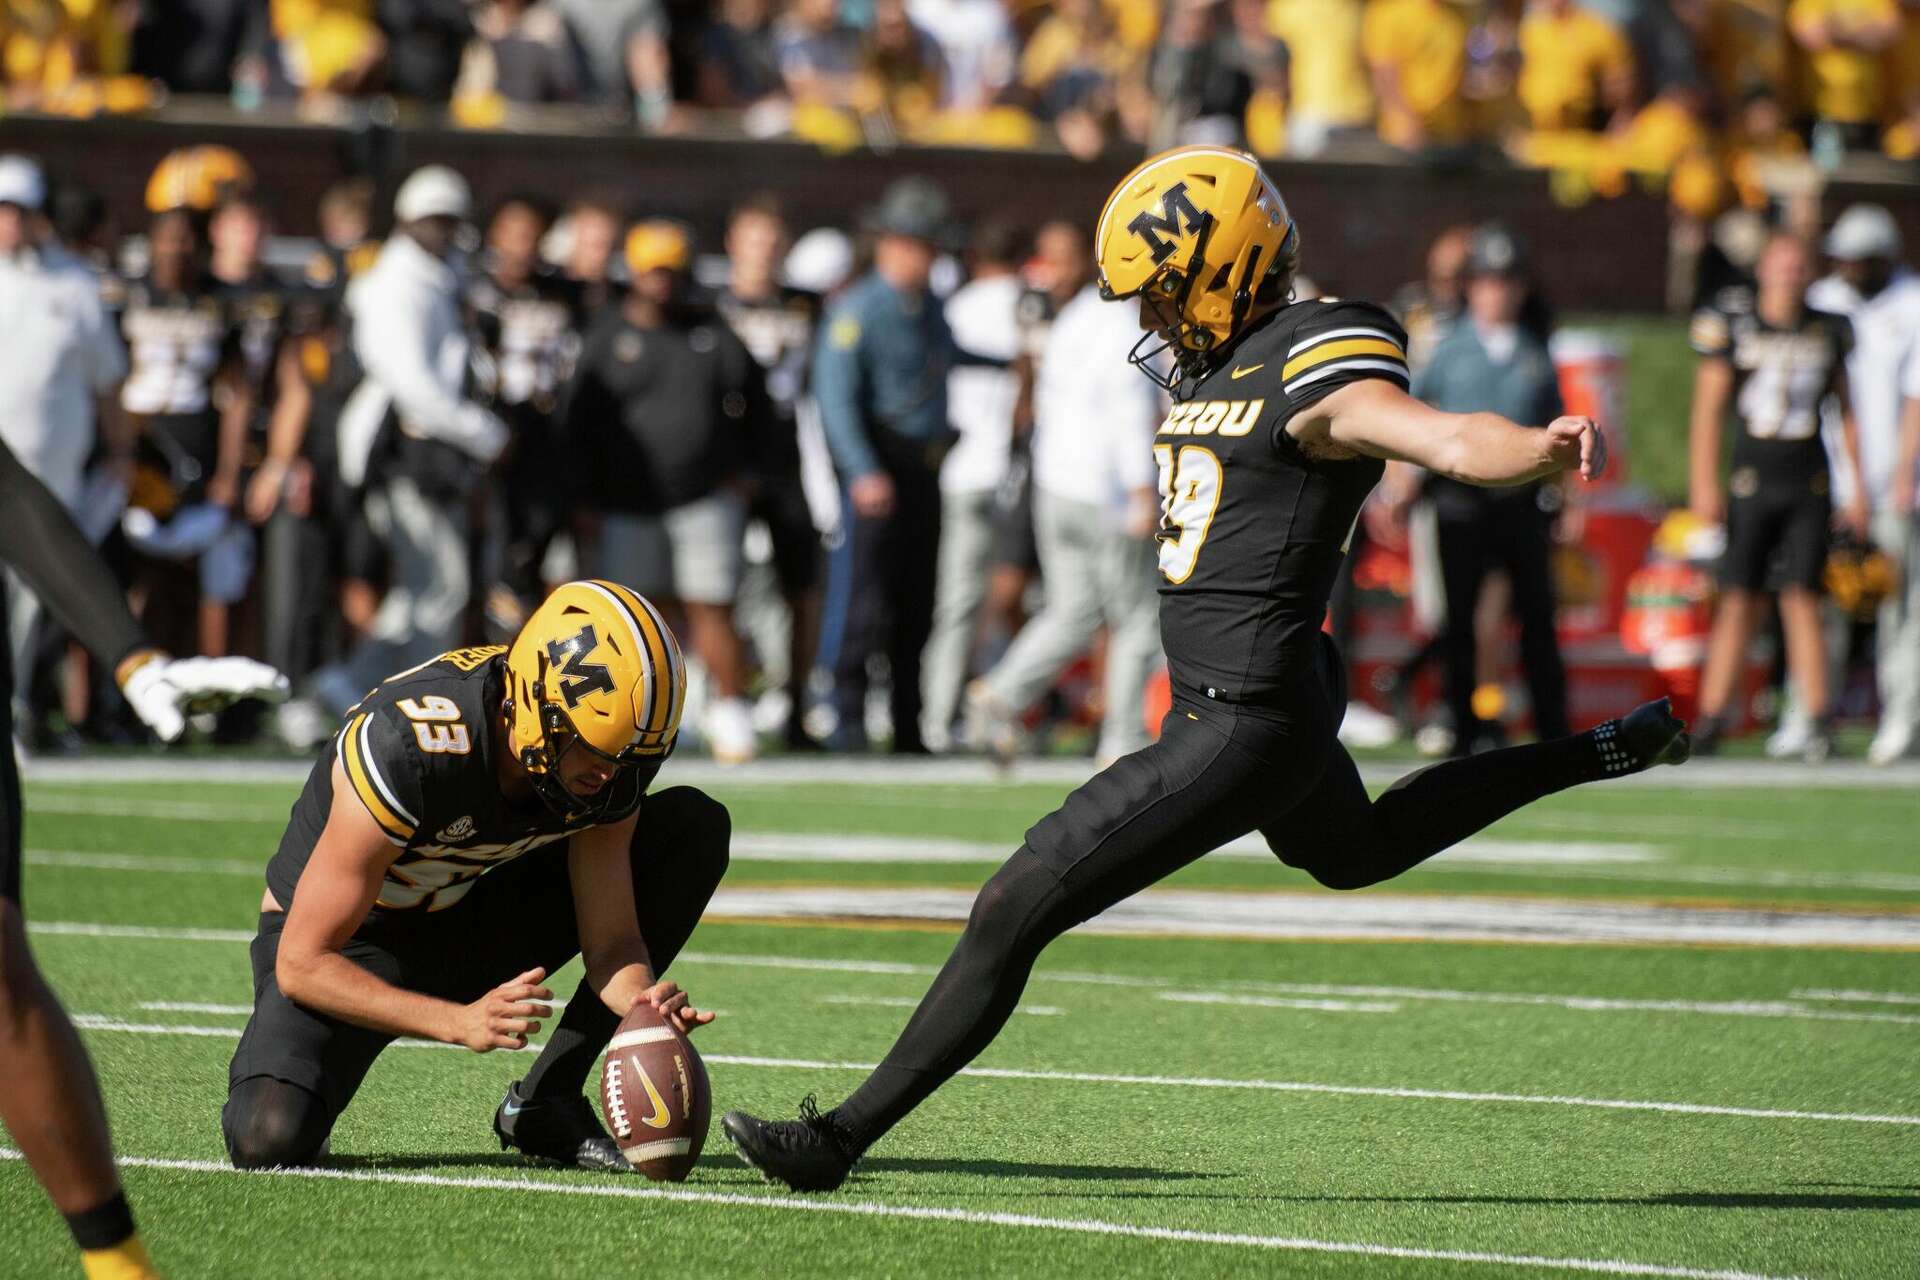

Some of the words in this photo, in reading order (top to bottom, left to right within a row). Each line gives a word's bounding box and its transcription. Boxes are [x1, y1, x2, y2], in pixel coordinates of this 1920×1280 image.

[1127, 181, 1210, 267] M
[1156, 399, 1265, 436] ZZOU
[546, 623, 618, 711] M
[396, 695, 472, 755] 93
